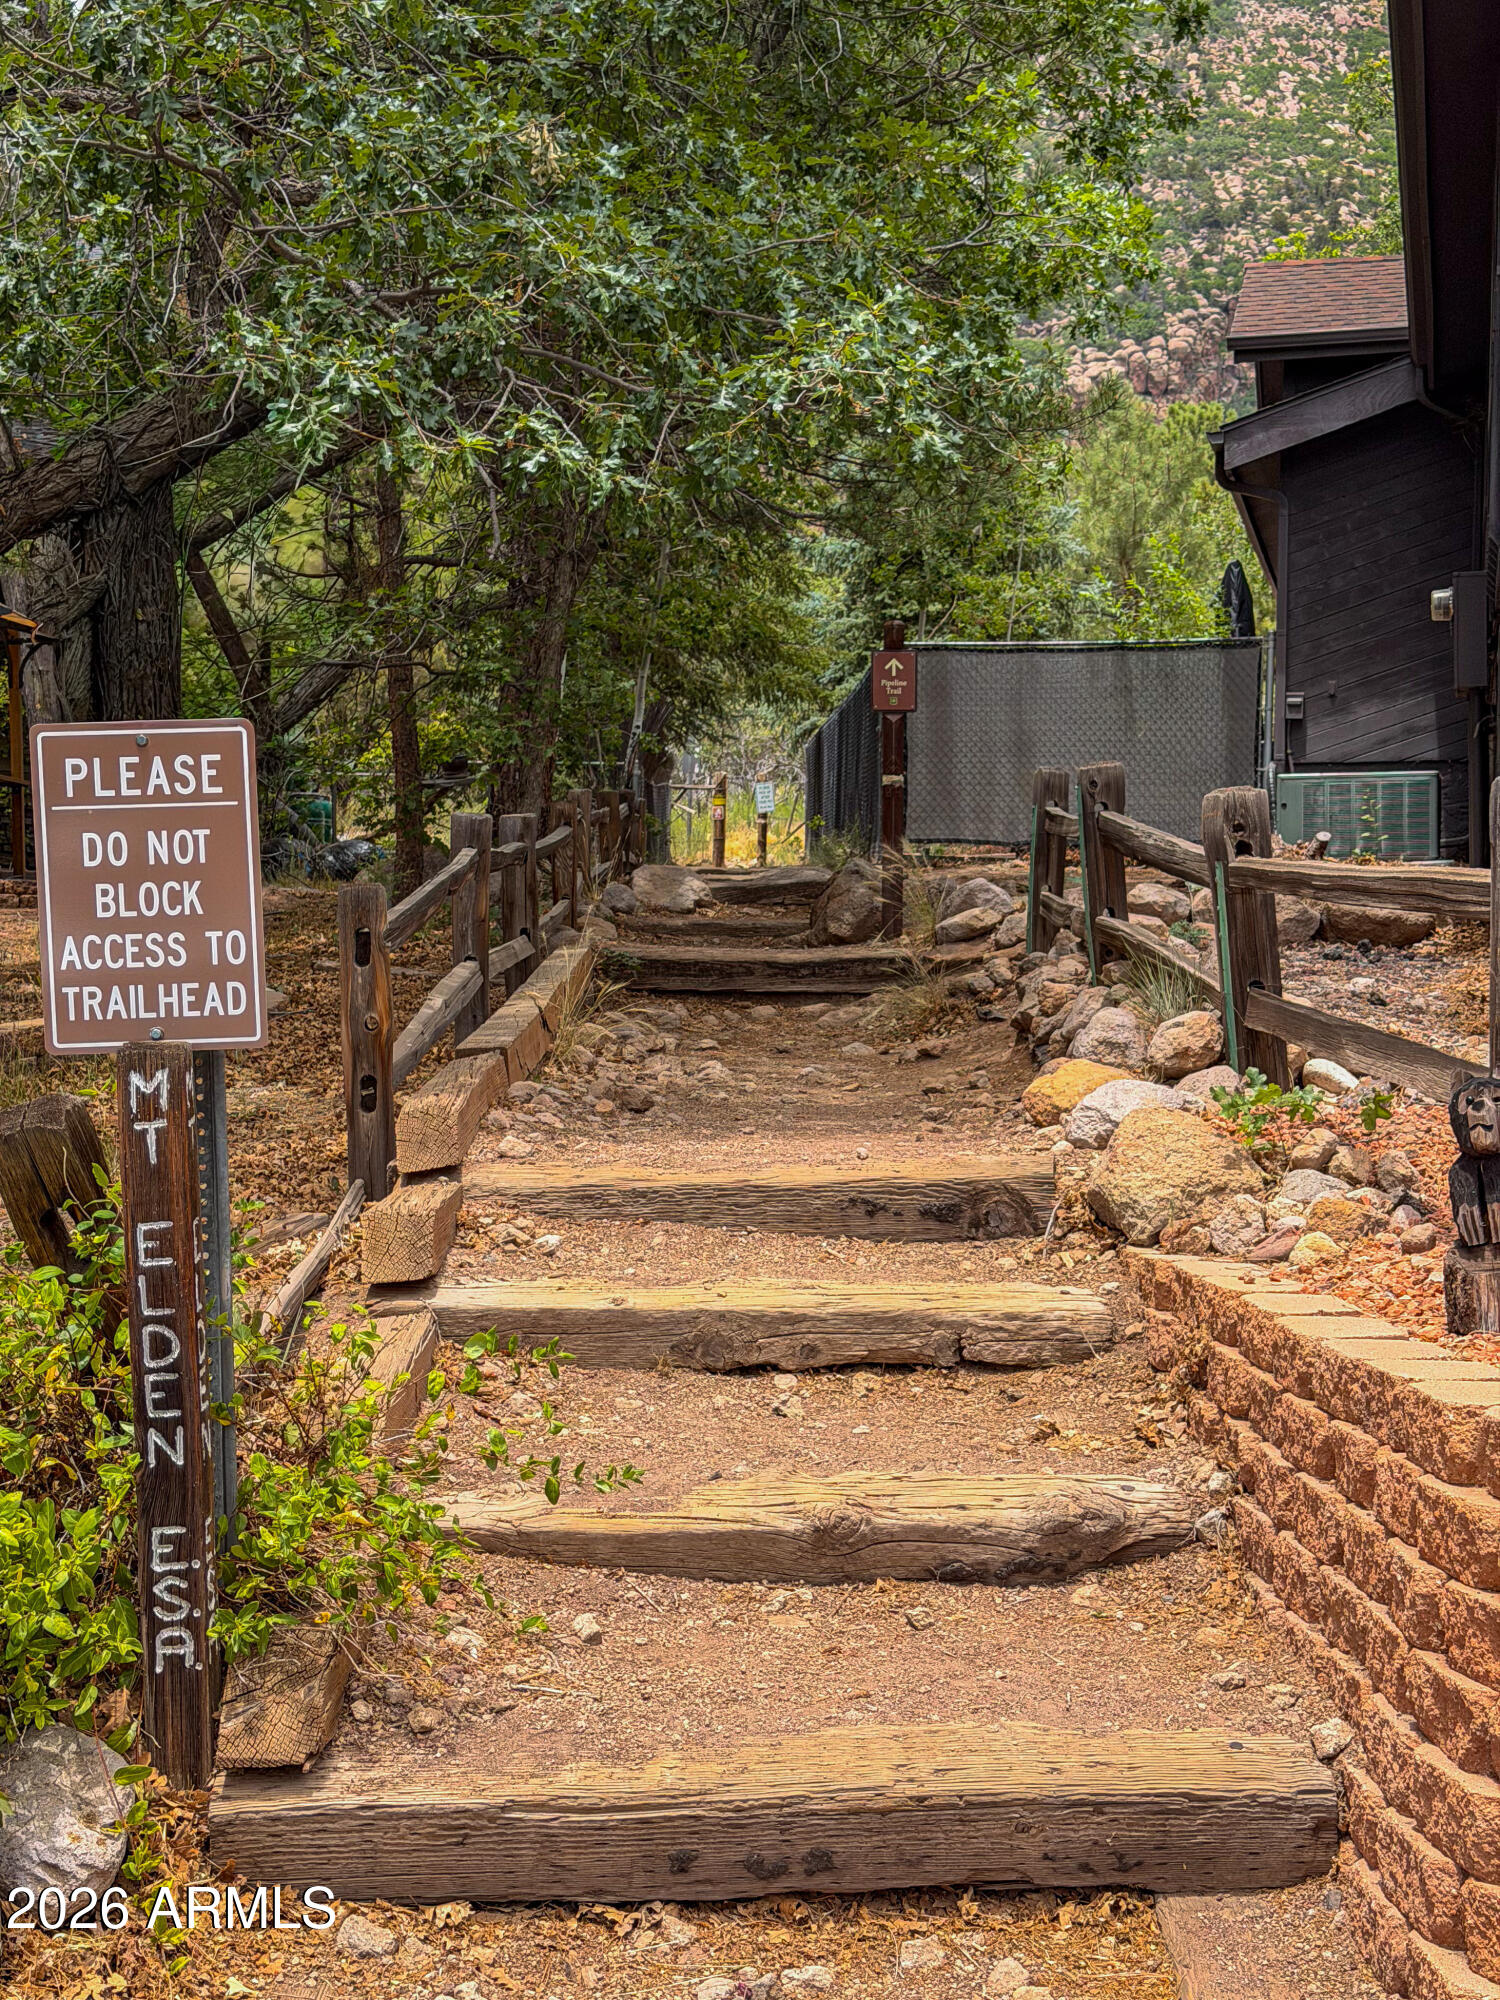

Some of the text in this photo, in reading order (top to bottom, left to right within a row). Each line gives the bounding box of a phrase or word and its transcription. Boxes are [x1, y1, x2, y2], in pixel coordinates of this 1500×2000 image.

[886, 687, 902, 695] Trail
[64, 754, 224, 798] PLEASE
[82, 829, 211, 867] DO NOT
[95, 880, 204, 918] BLOCK
[60, 929, 247, 970] ACCESS TO
[61, 981, 248, 1021] TRAILHEAD
[129, 1067, 169, 1165] MT
[136, 1220, 184, 1468] ELDEN
